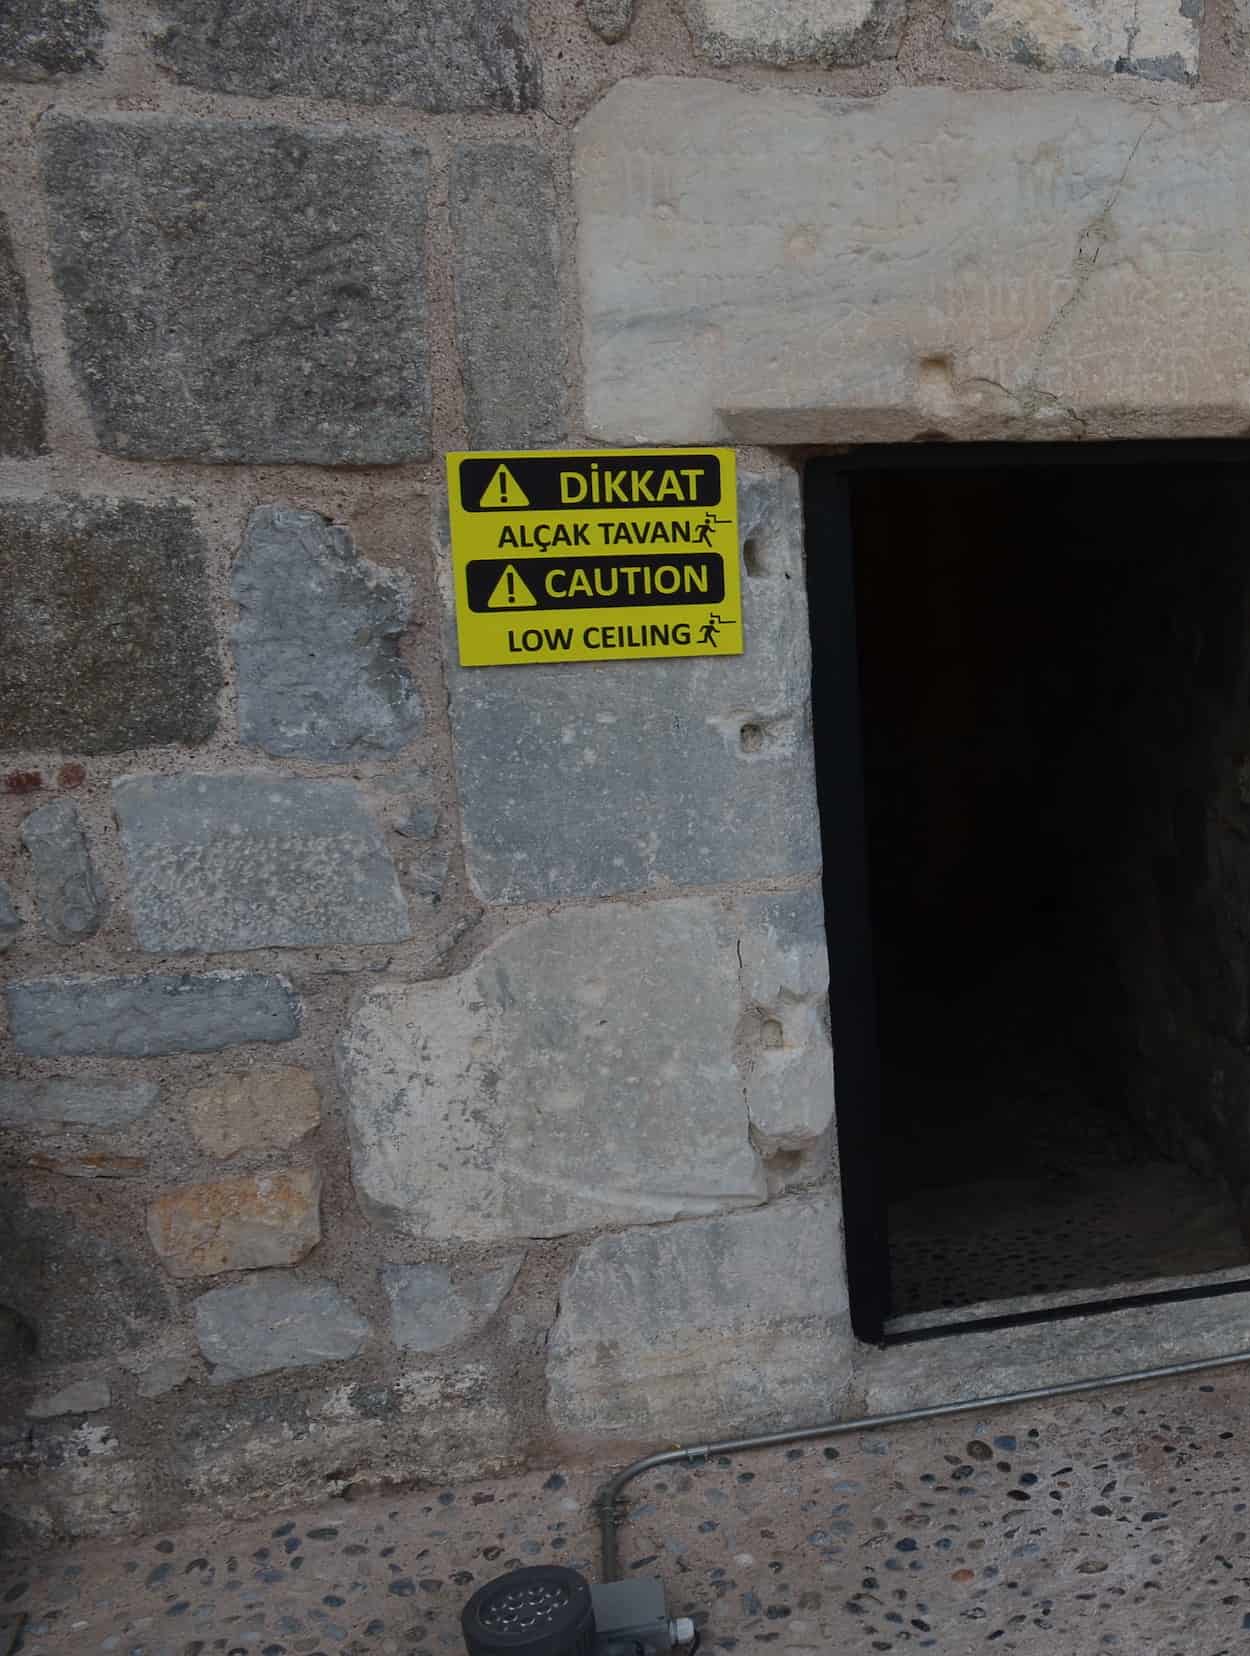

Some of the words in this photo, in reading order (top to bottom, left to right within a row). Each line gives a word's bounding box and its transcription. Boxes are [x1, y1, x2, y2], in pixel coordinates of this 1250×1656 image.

[560, 463, 705, 503] DİKKAT
[498, 524, 590, 552] ALÇAK
[598, 521, 691, 544] TAVAN
[544, 564, 708, 597] CAUTION
[508, 628, 573, 652] LOW
[583, 623, 691, 648] CEILING
